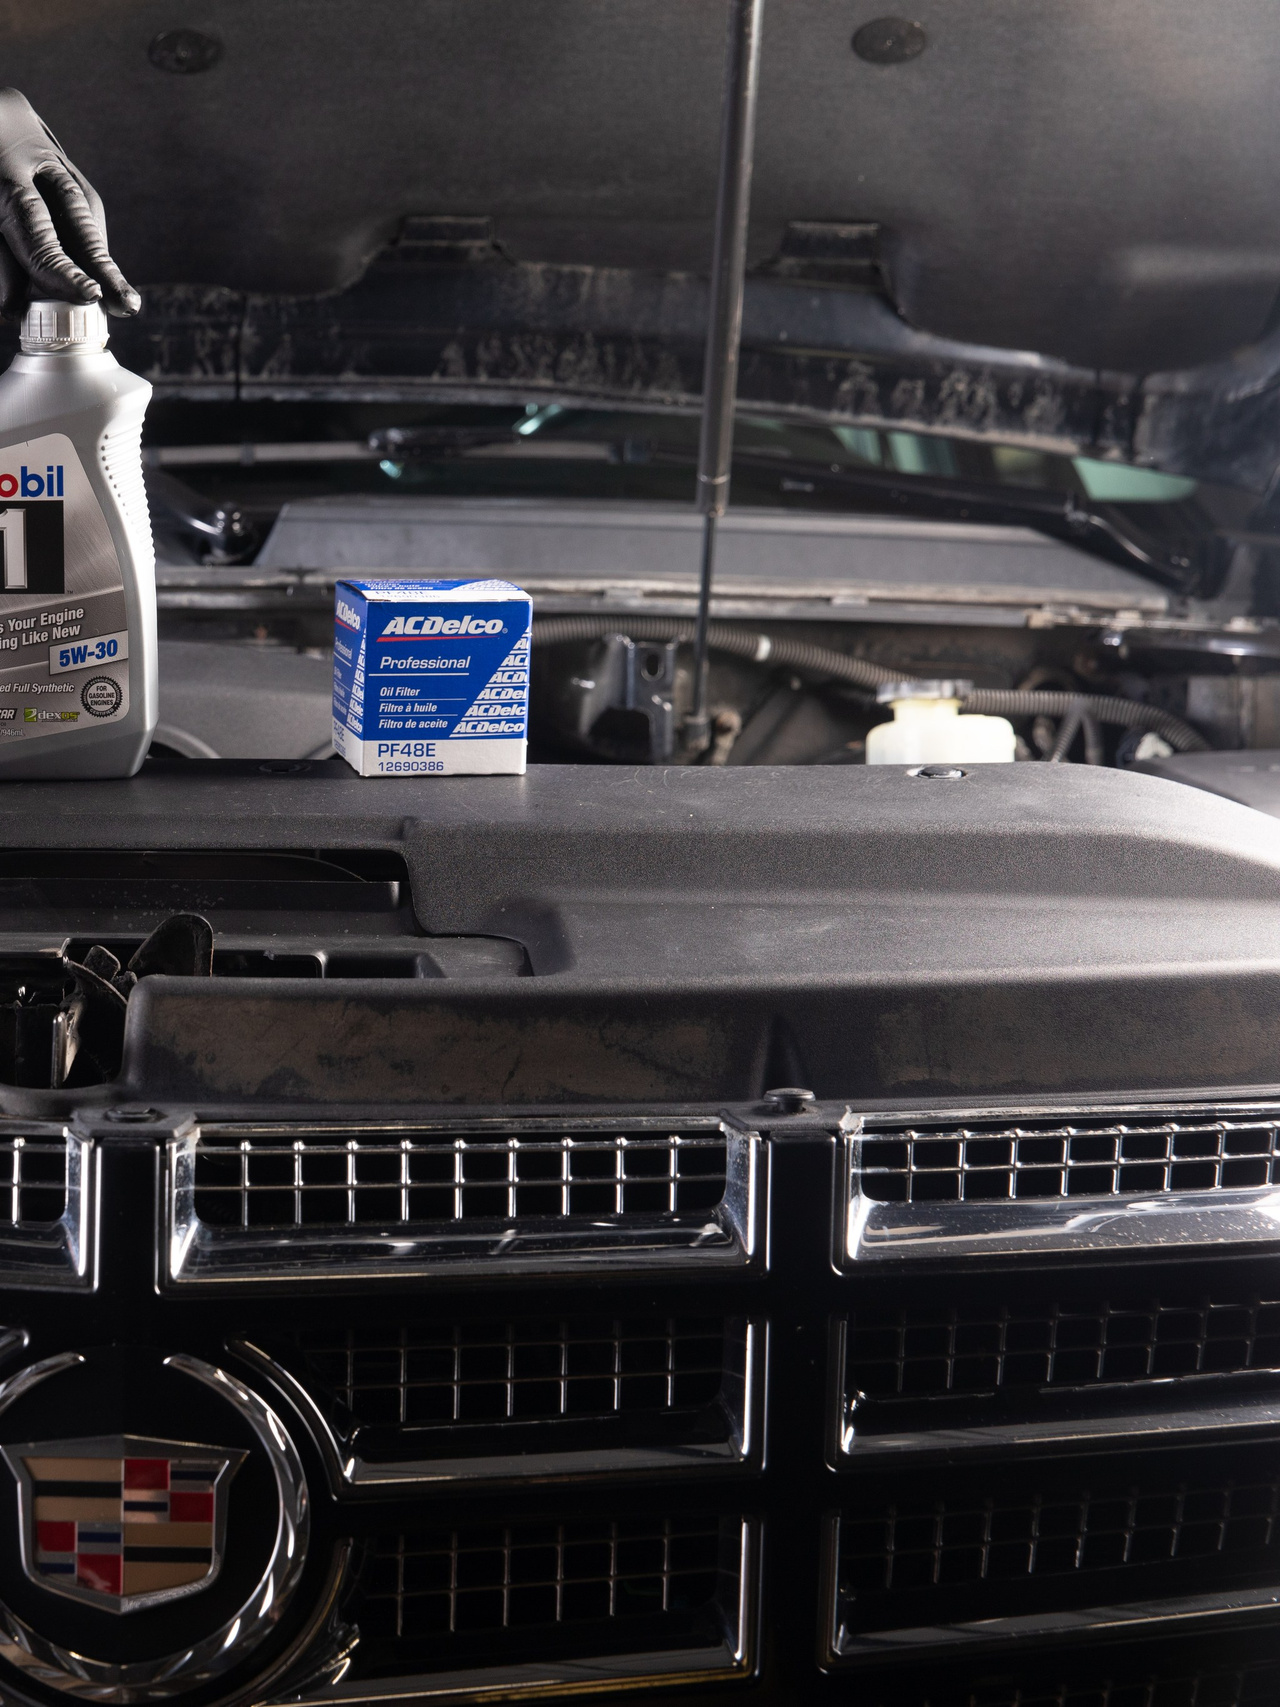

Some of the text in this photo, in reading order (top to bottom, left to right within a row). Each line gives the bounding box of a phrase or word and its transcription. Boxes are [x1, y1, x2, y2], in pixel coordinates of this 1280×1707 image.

[8, 616, 37, 632] Your
[40, 607, 84, 626] Engine
[381, 615, 504, 635] ACDelco
[22, 630, 49, 646] Like
[52, 624, 81, 640] New
[59, 638, 118, 668] 5W-30
[380, 656, 471, 669] Professional
[13, 683, 31, 693] Full
[31, 683, 75, 695] Synthetic
[380, 686, 420, 697] Oil Filter
[379, 703, 437, 713] Filtre à huile
[38, 710, 78, 720] dexos
[379, 719, 448, 729] Filtro de aceite
[452, 721, 525, 733] ACDelco
[378, 742, 436, 758] PF48E
[378, 761, 444, 772] 12690386
